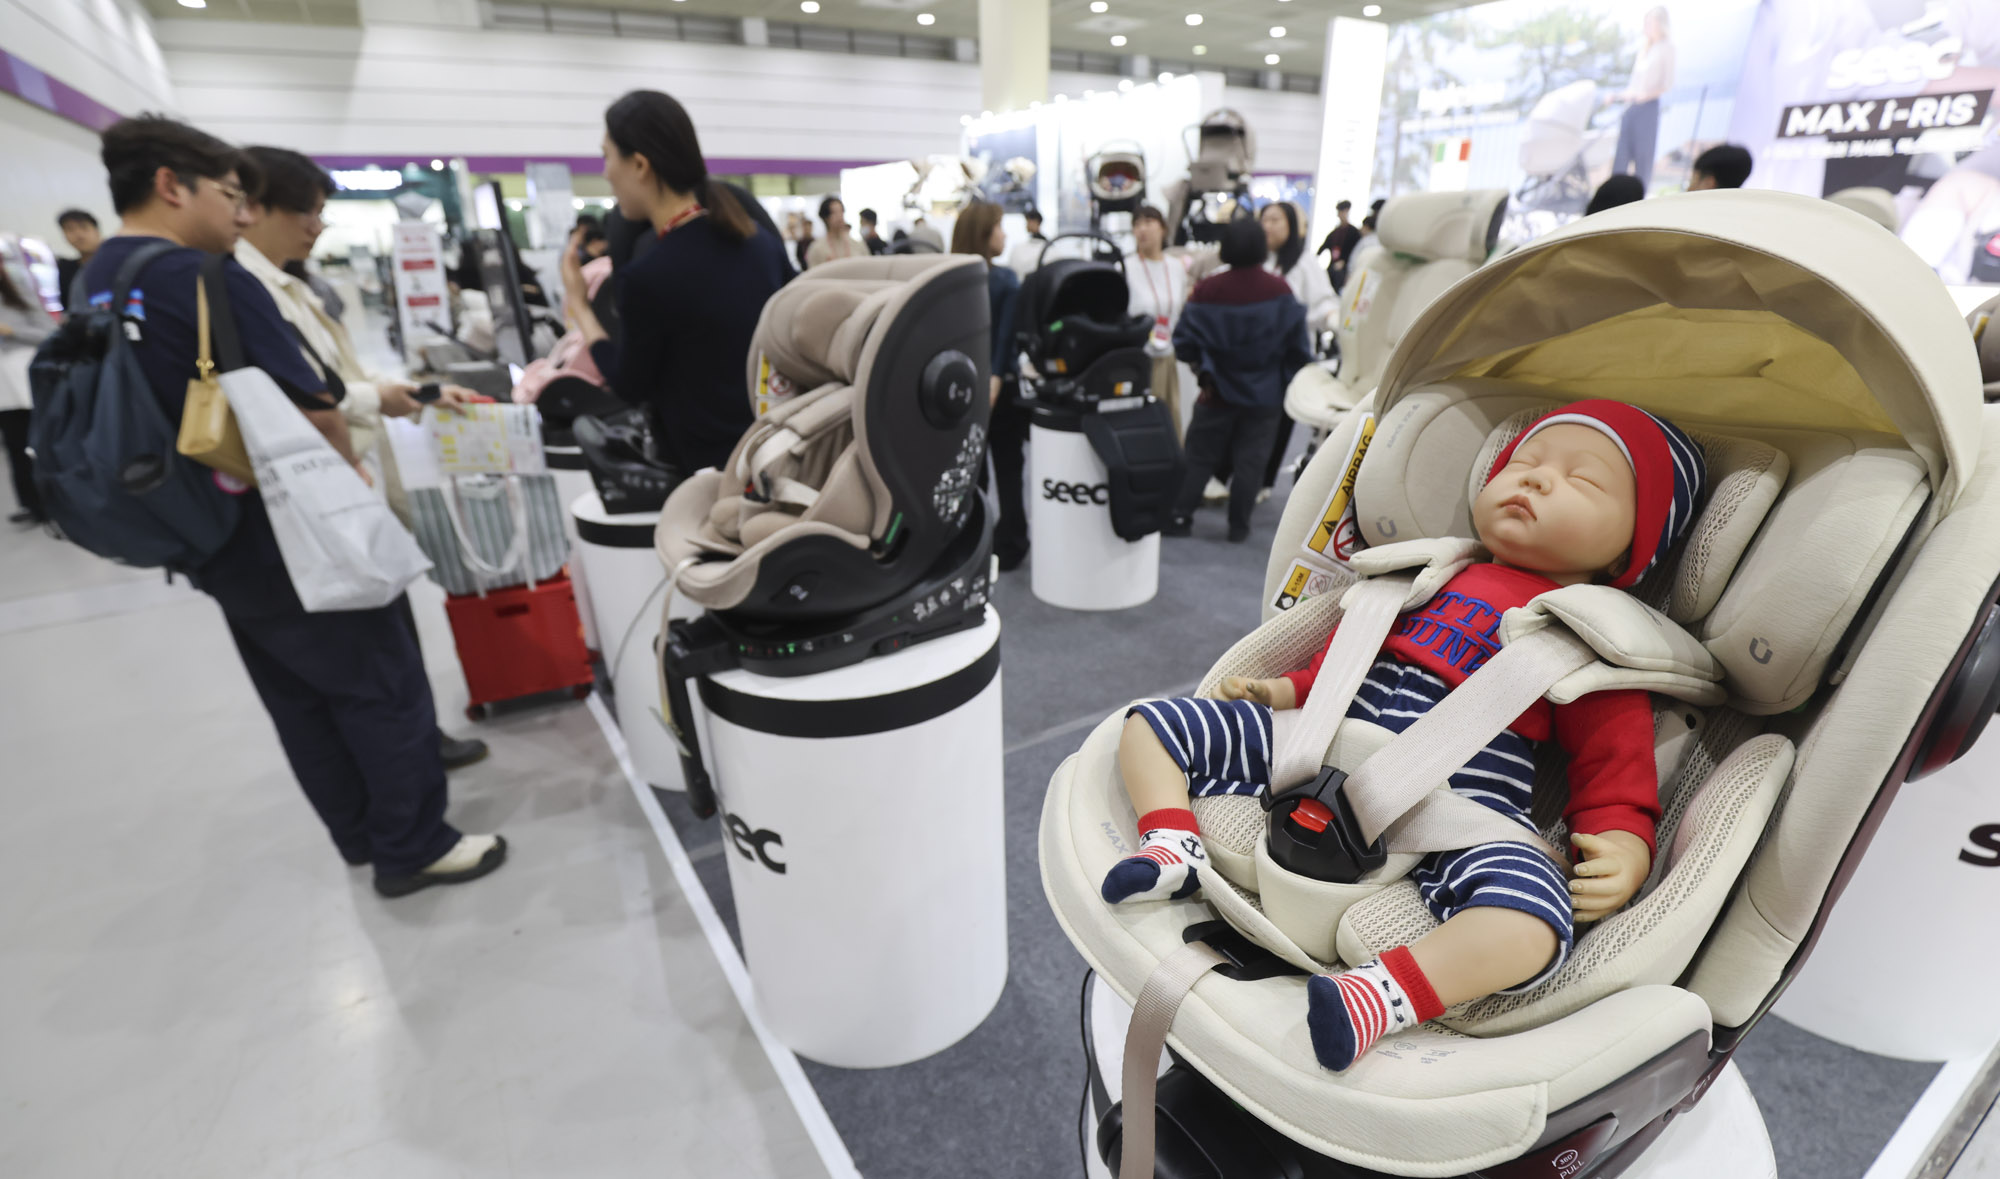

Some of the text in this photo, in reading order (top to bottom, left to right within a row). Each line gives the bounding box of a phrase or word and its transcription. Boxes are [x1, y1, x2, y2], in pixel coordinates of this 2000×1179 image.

[1785, 101, 1876, 137] MAX
[1342, 434, 1373, 497] AIRBAG
[1043, 479, 1108, 505] seec
[726, 813, 786, 875] ec
[1101, 821, 1129, 854] MAX
[1560, 1161, 1585, 1179] PULL
